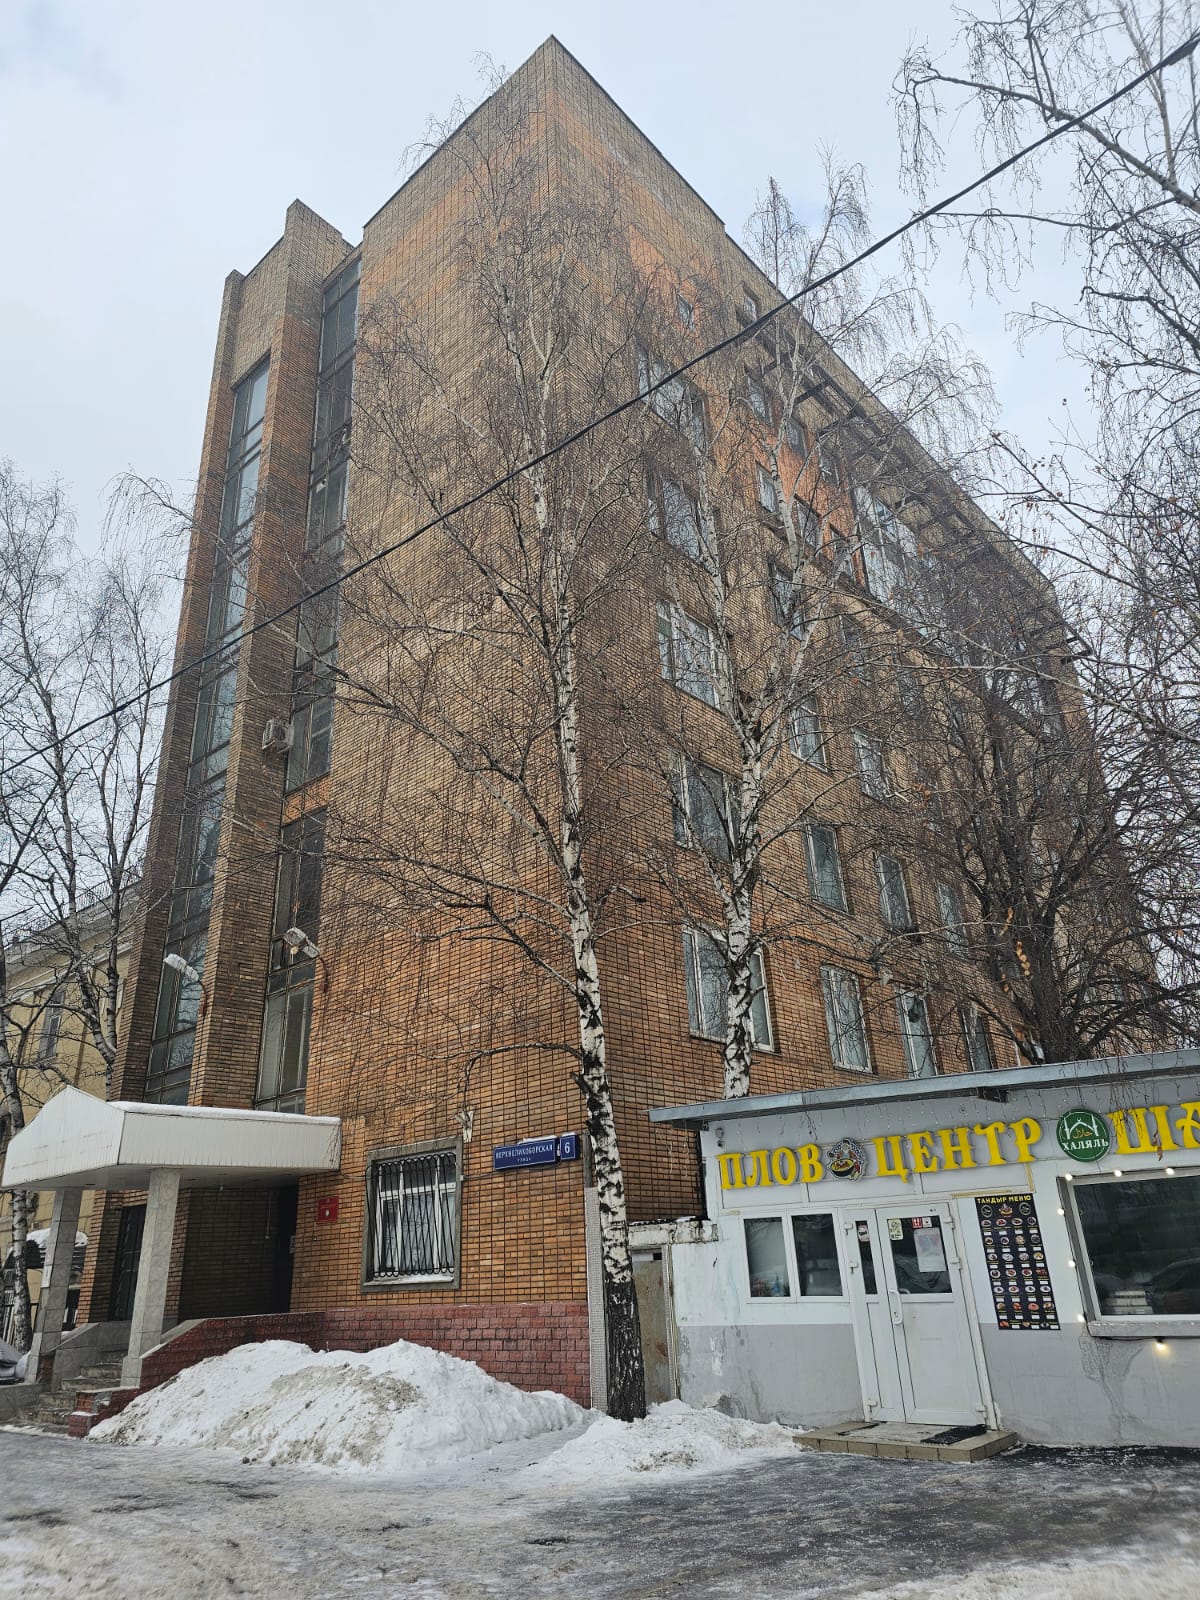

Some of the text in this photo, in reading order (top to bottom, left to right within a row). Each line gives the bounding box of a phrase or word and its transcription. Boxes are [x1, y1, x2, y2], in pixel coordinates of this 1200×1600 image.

[495, 1144, 553, 1159] ВЕРХНЕЛИХОБОРСКАЯ
[564, 1142, 571, 1154] 6
[1061, 1138, 1109, 1151] ХАЛЯЛЬ
[716, 1117, 1041, 1190] ПЛОВ ЦЕНТР
